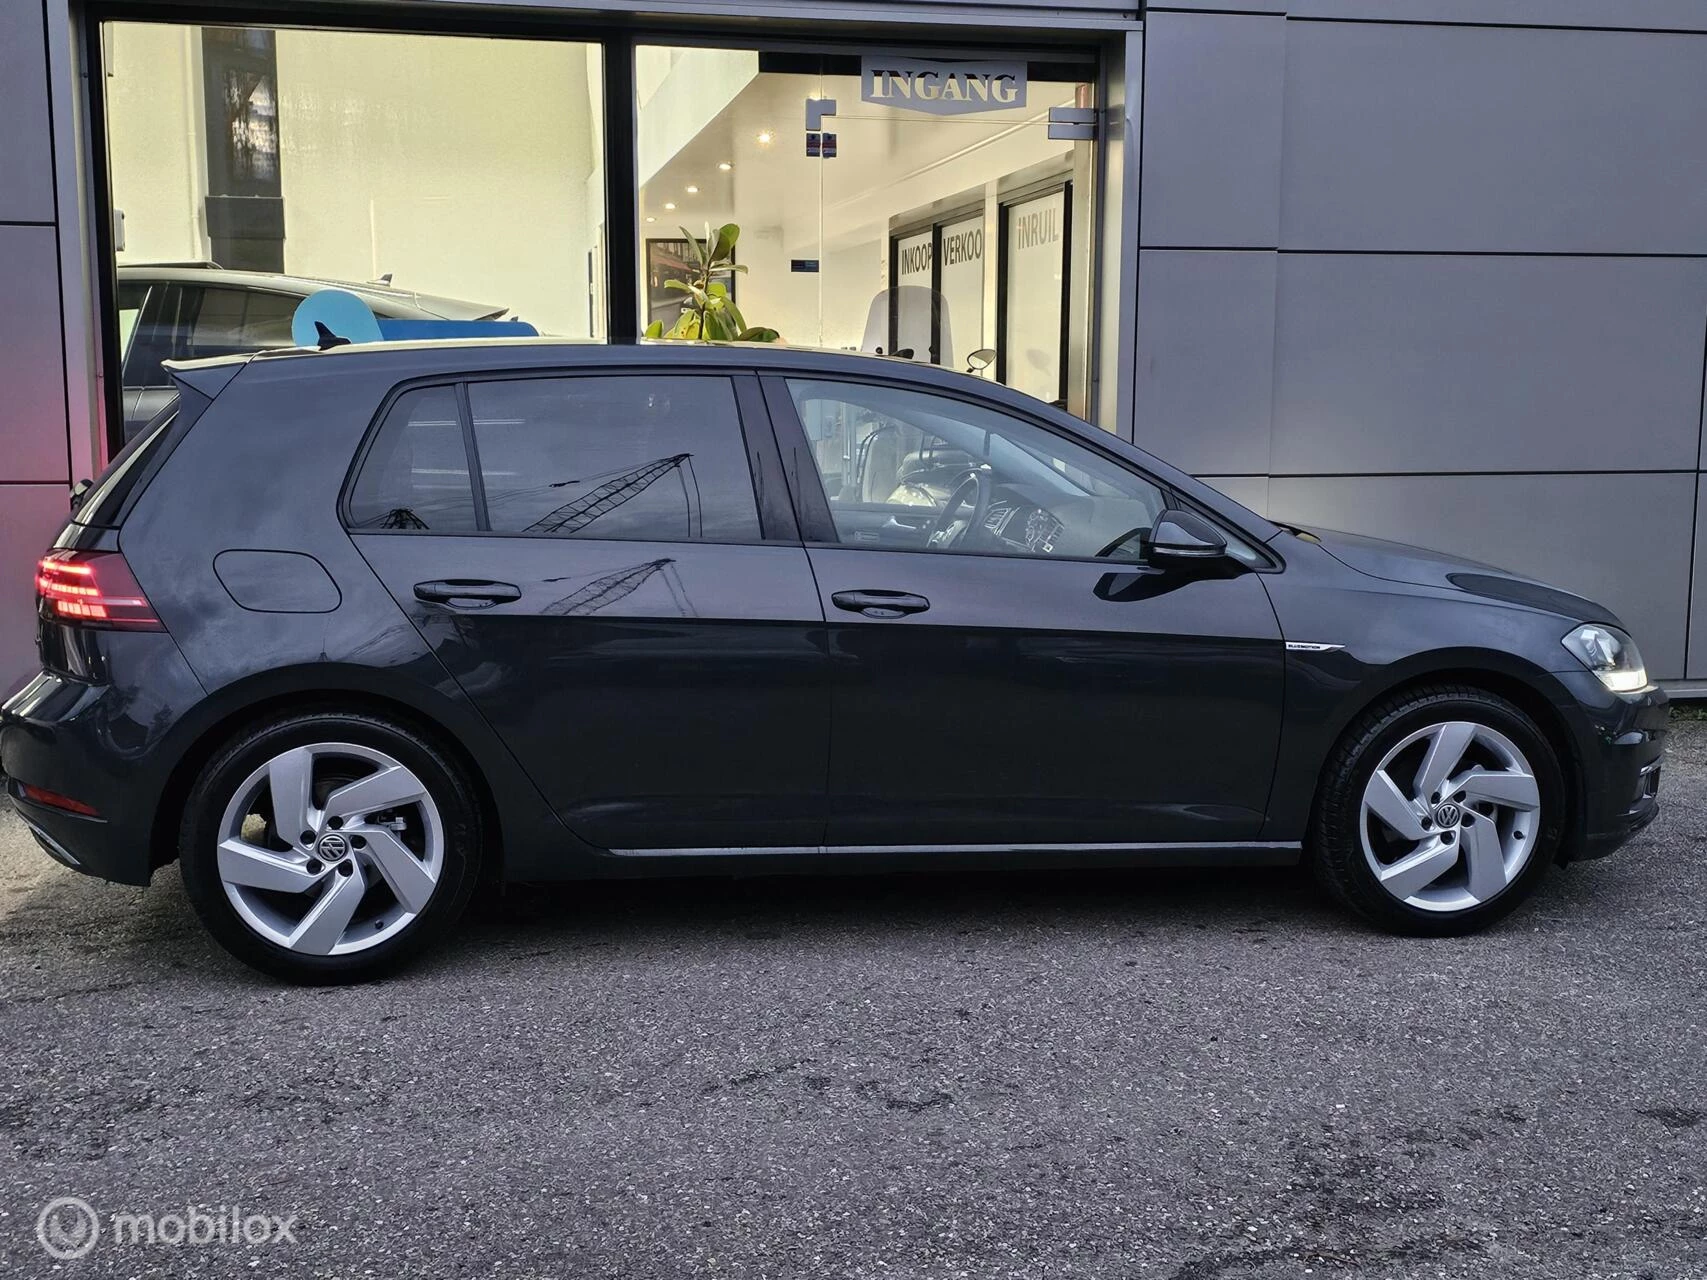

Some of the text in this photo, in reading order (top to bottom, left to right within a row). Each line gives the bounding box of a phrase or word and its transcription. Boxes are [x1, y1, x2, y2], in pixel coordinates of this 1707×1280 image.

[871, 70, 1017, 102] INGANG
[1018, 208, 1059, 250] INRUIL
[901, 242, 932, 275] INKOOP
[943, 229, 983, 266] VERKOO
